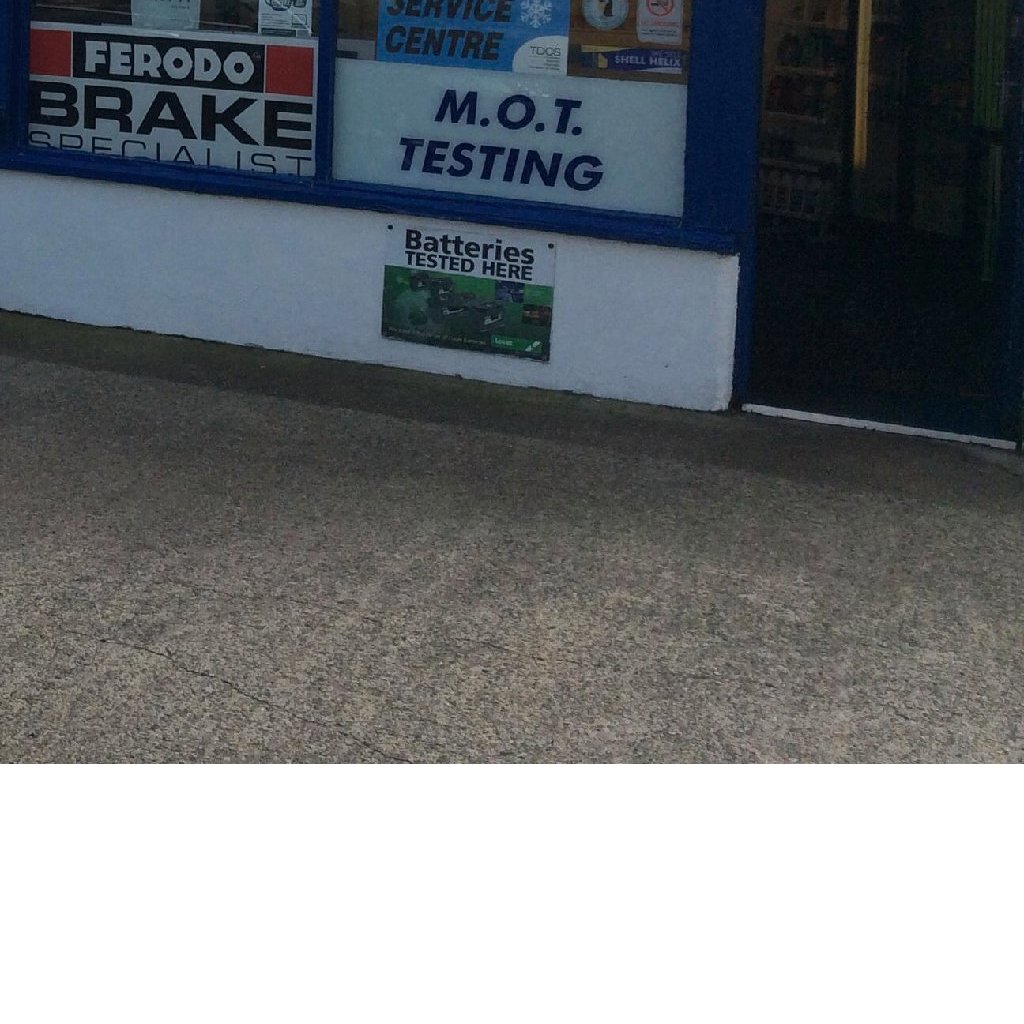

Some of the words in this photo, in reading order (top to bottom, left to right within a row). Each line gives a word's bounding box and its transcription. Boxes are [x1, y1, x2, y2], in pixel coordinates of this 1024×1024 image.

[84, 40, 255, 85] FERODO
[384, 25, 505, 60] CENTRE
[614, 55, 648, 65] SHELL
[648, 57, 681, 67] HELIX
[28, 80, 314, 151] BRAKE
[434, 89, 583, 136] M.O.T.
[400, 137, 604, 192] TESTING
[405, 228, 535, 265] Batteries
[405, 250, 475, 273] TESTED
[481, 260, 534, 282] HERE
